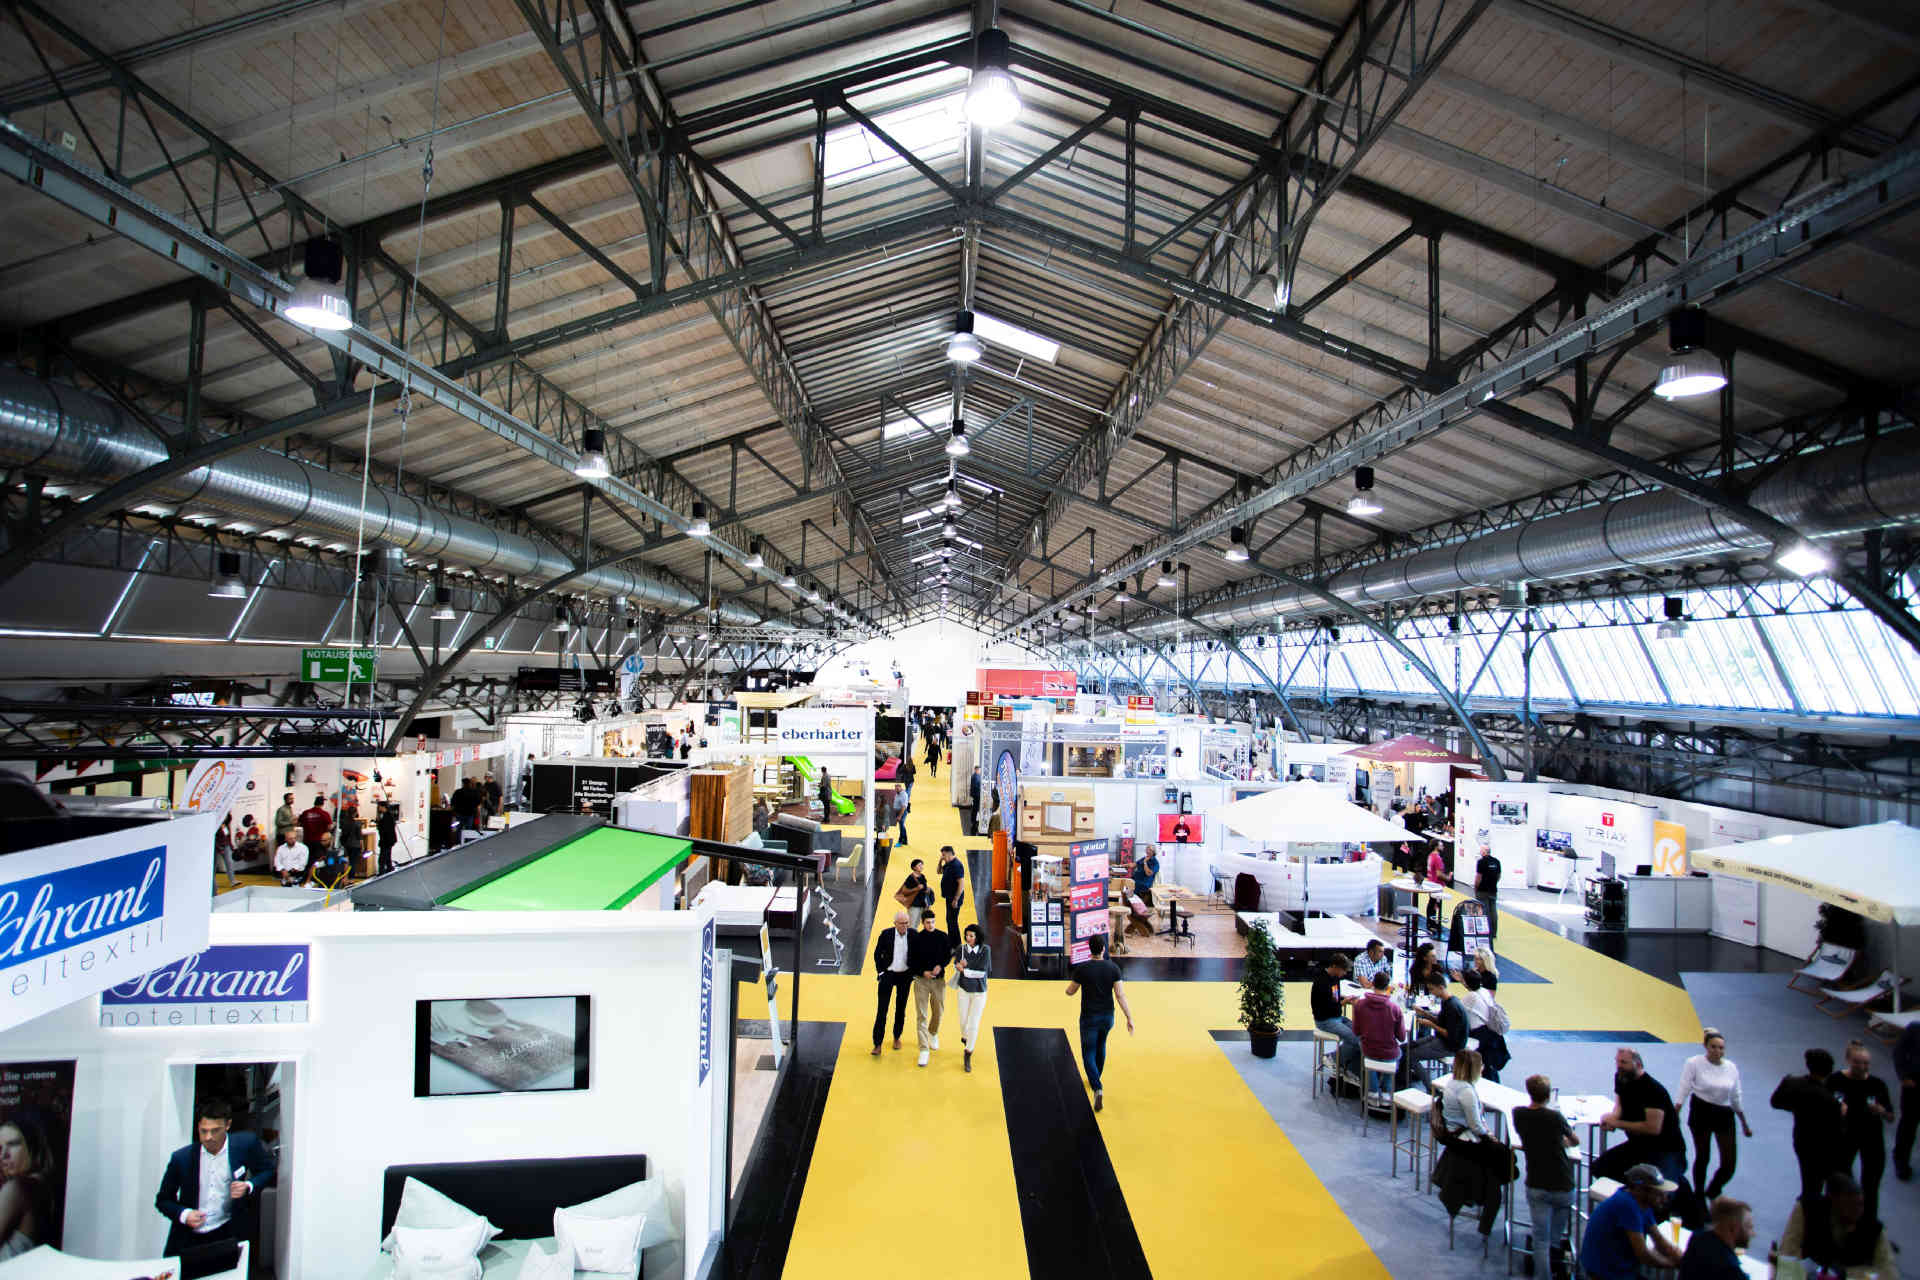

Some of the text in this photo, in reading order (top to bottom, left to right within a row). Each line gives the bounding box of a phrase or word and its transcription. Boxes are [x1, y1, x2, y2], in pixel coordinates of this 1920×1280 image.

[306, 650, 374, 660] NOTAUSGANG
[782, 728, 863, 740] eberharter
[101, 1003, 309, 1027] hoteltextil
